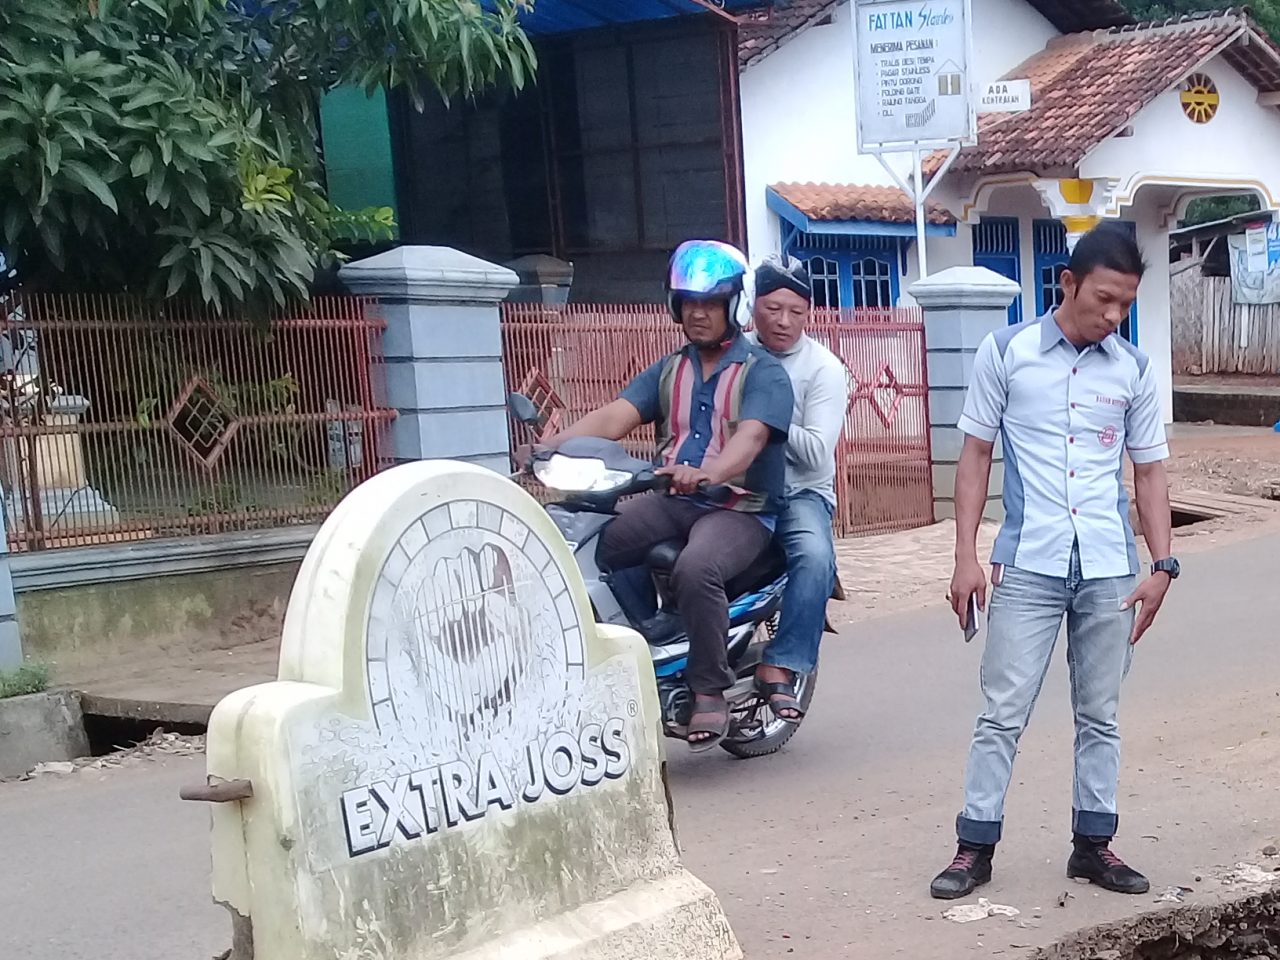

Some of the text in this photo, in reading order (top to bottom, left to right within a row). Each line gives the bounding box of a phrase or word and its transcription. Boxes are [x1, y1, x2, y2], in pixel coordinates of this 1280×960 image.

[869, 10, 913, 31] FATTAN
[870, 41, 904, 55] MENERIMA
[906, 38, 934, 52] PESANAN
[988, 84, 1009, 95] ADA
[340, 751, 516, 858] EXTRA
[522, 717, 631, 803] JOSS
